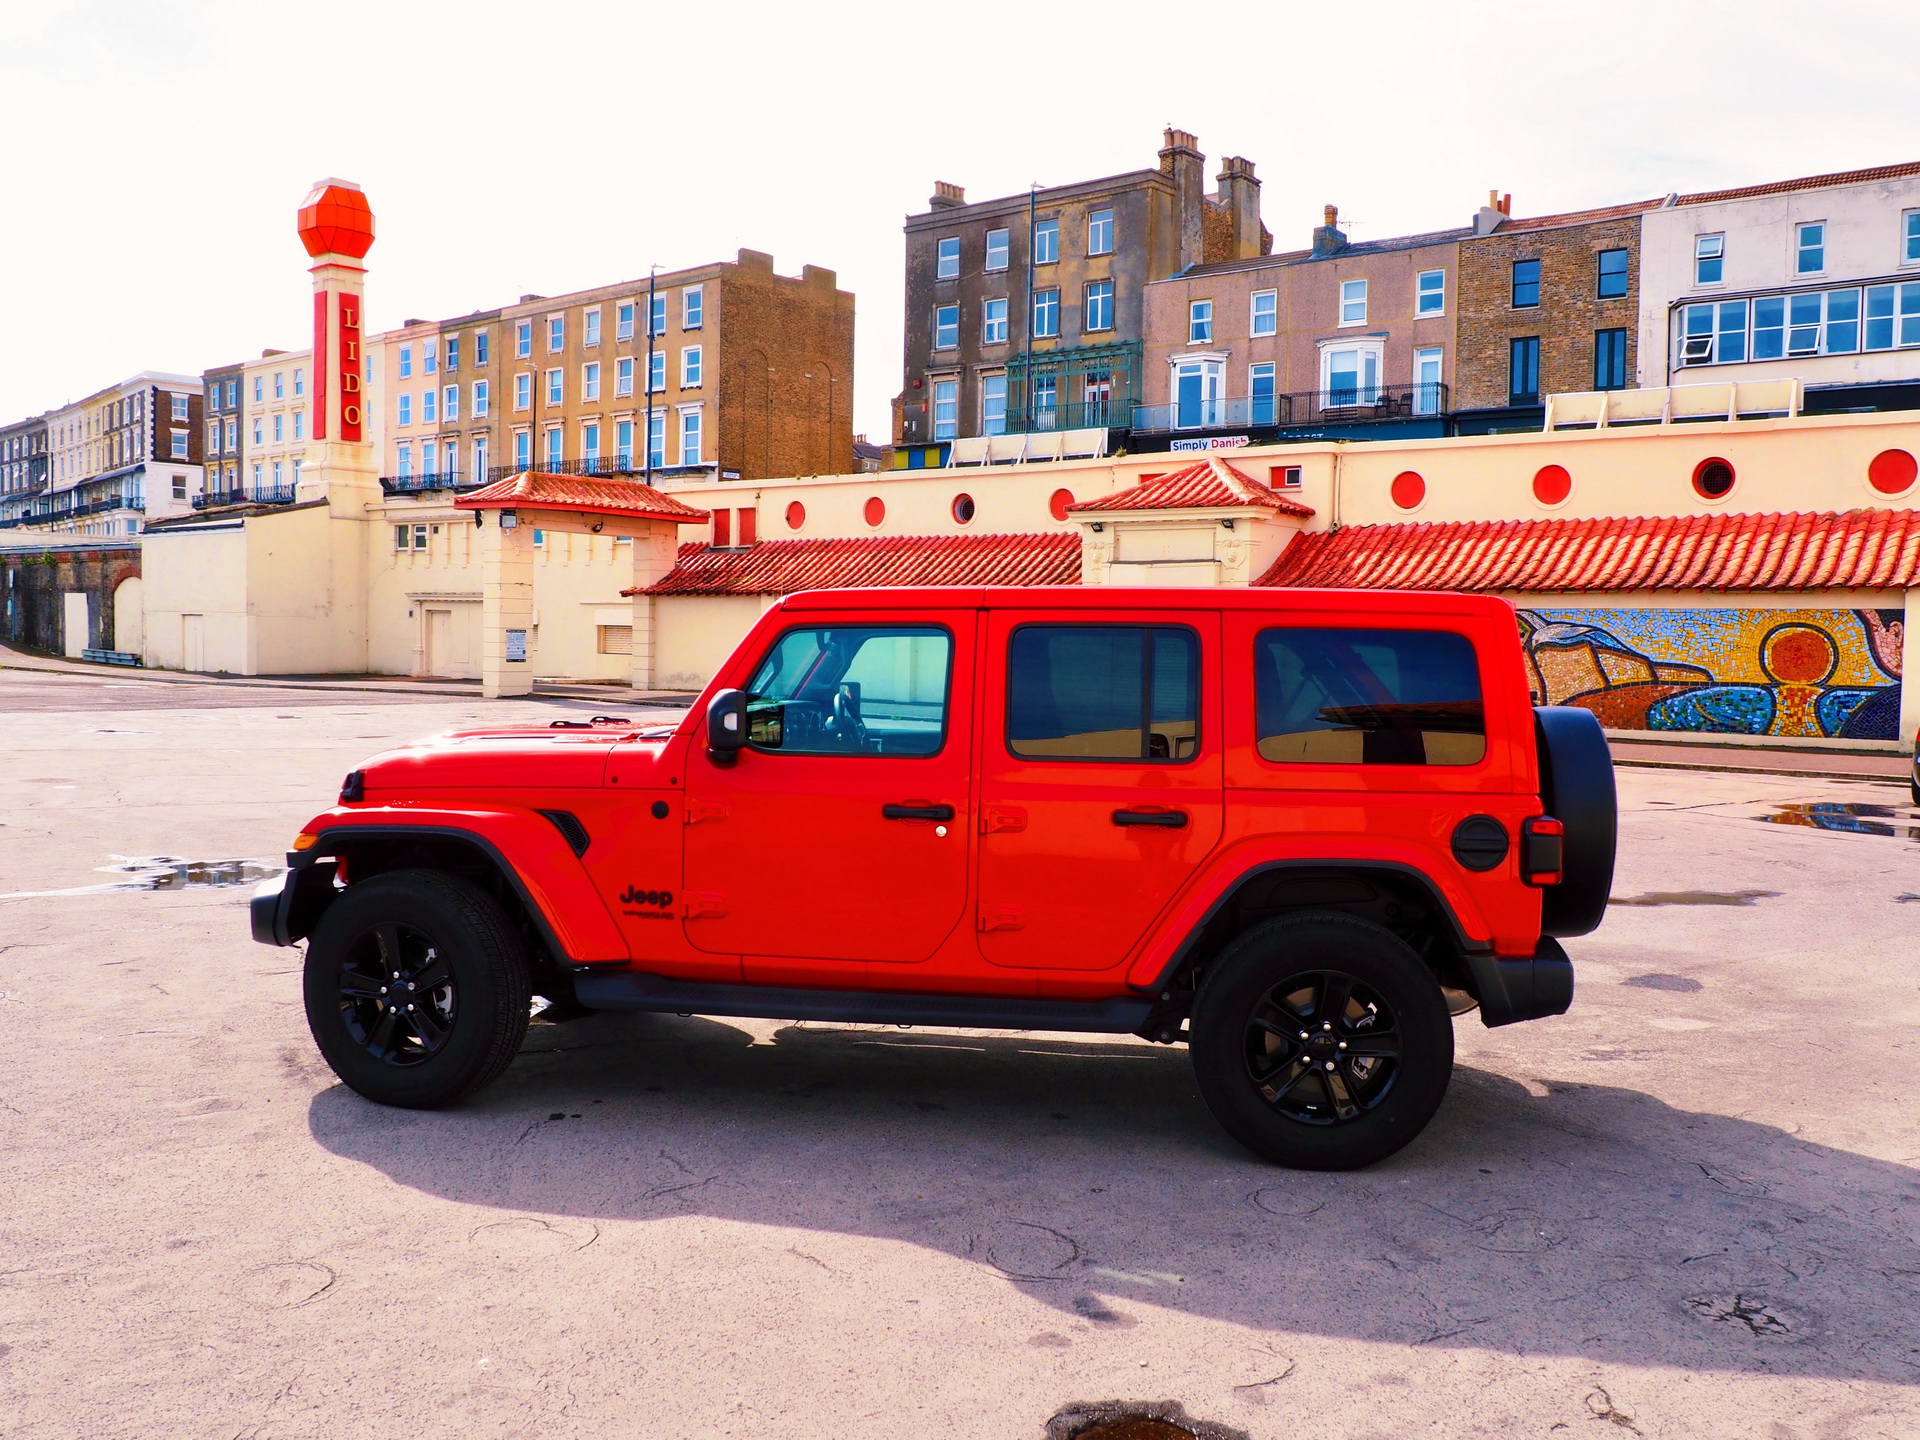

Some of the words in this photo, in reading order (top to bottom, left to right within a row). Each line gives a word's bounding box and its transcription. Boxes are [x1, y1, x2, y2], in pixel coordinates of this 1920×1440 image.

[344, 308, 361, 425] LIDO
[1173, 439, 1208, 451] Simply
[620, 885, 672, 909] Jeep
